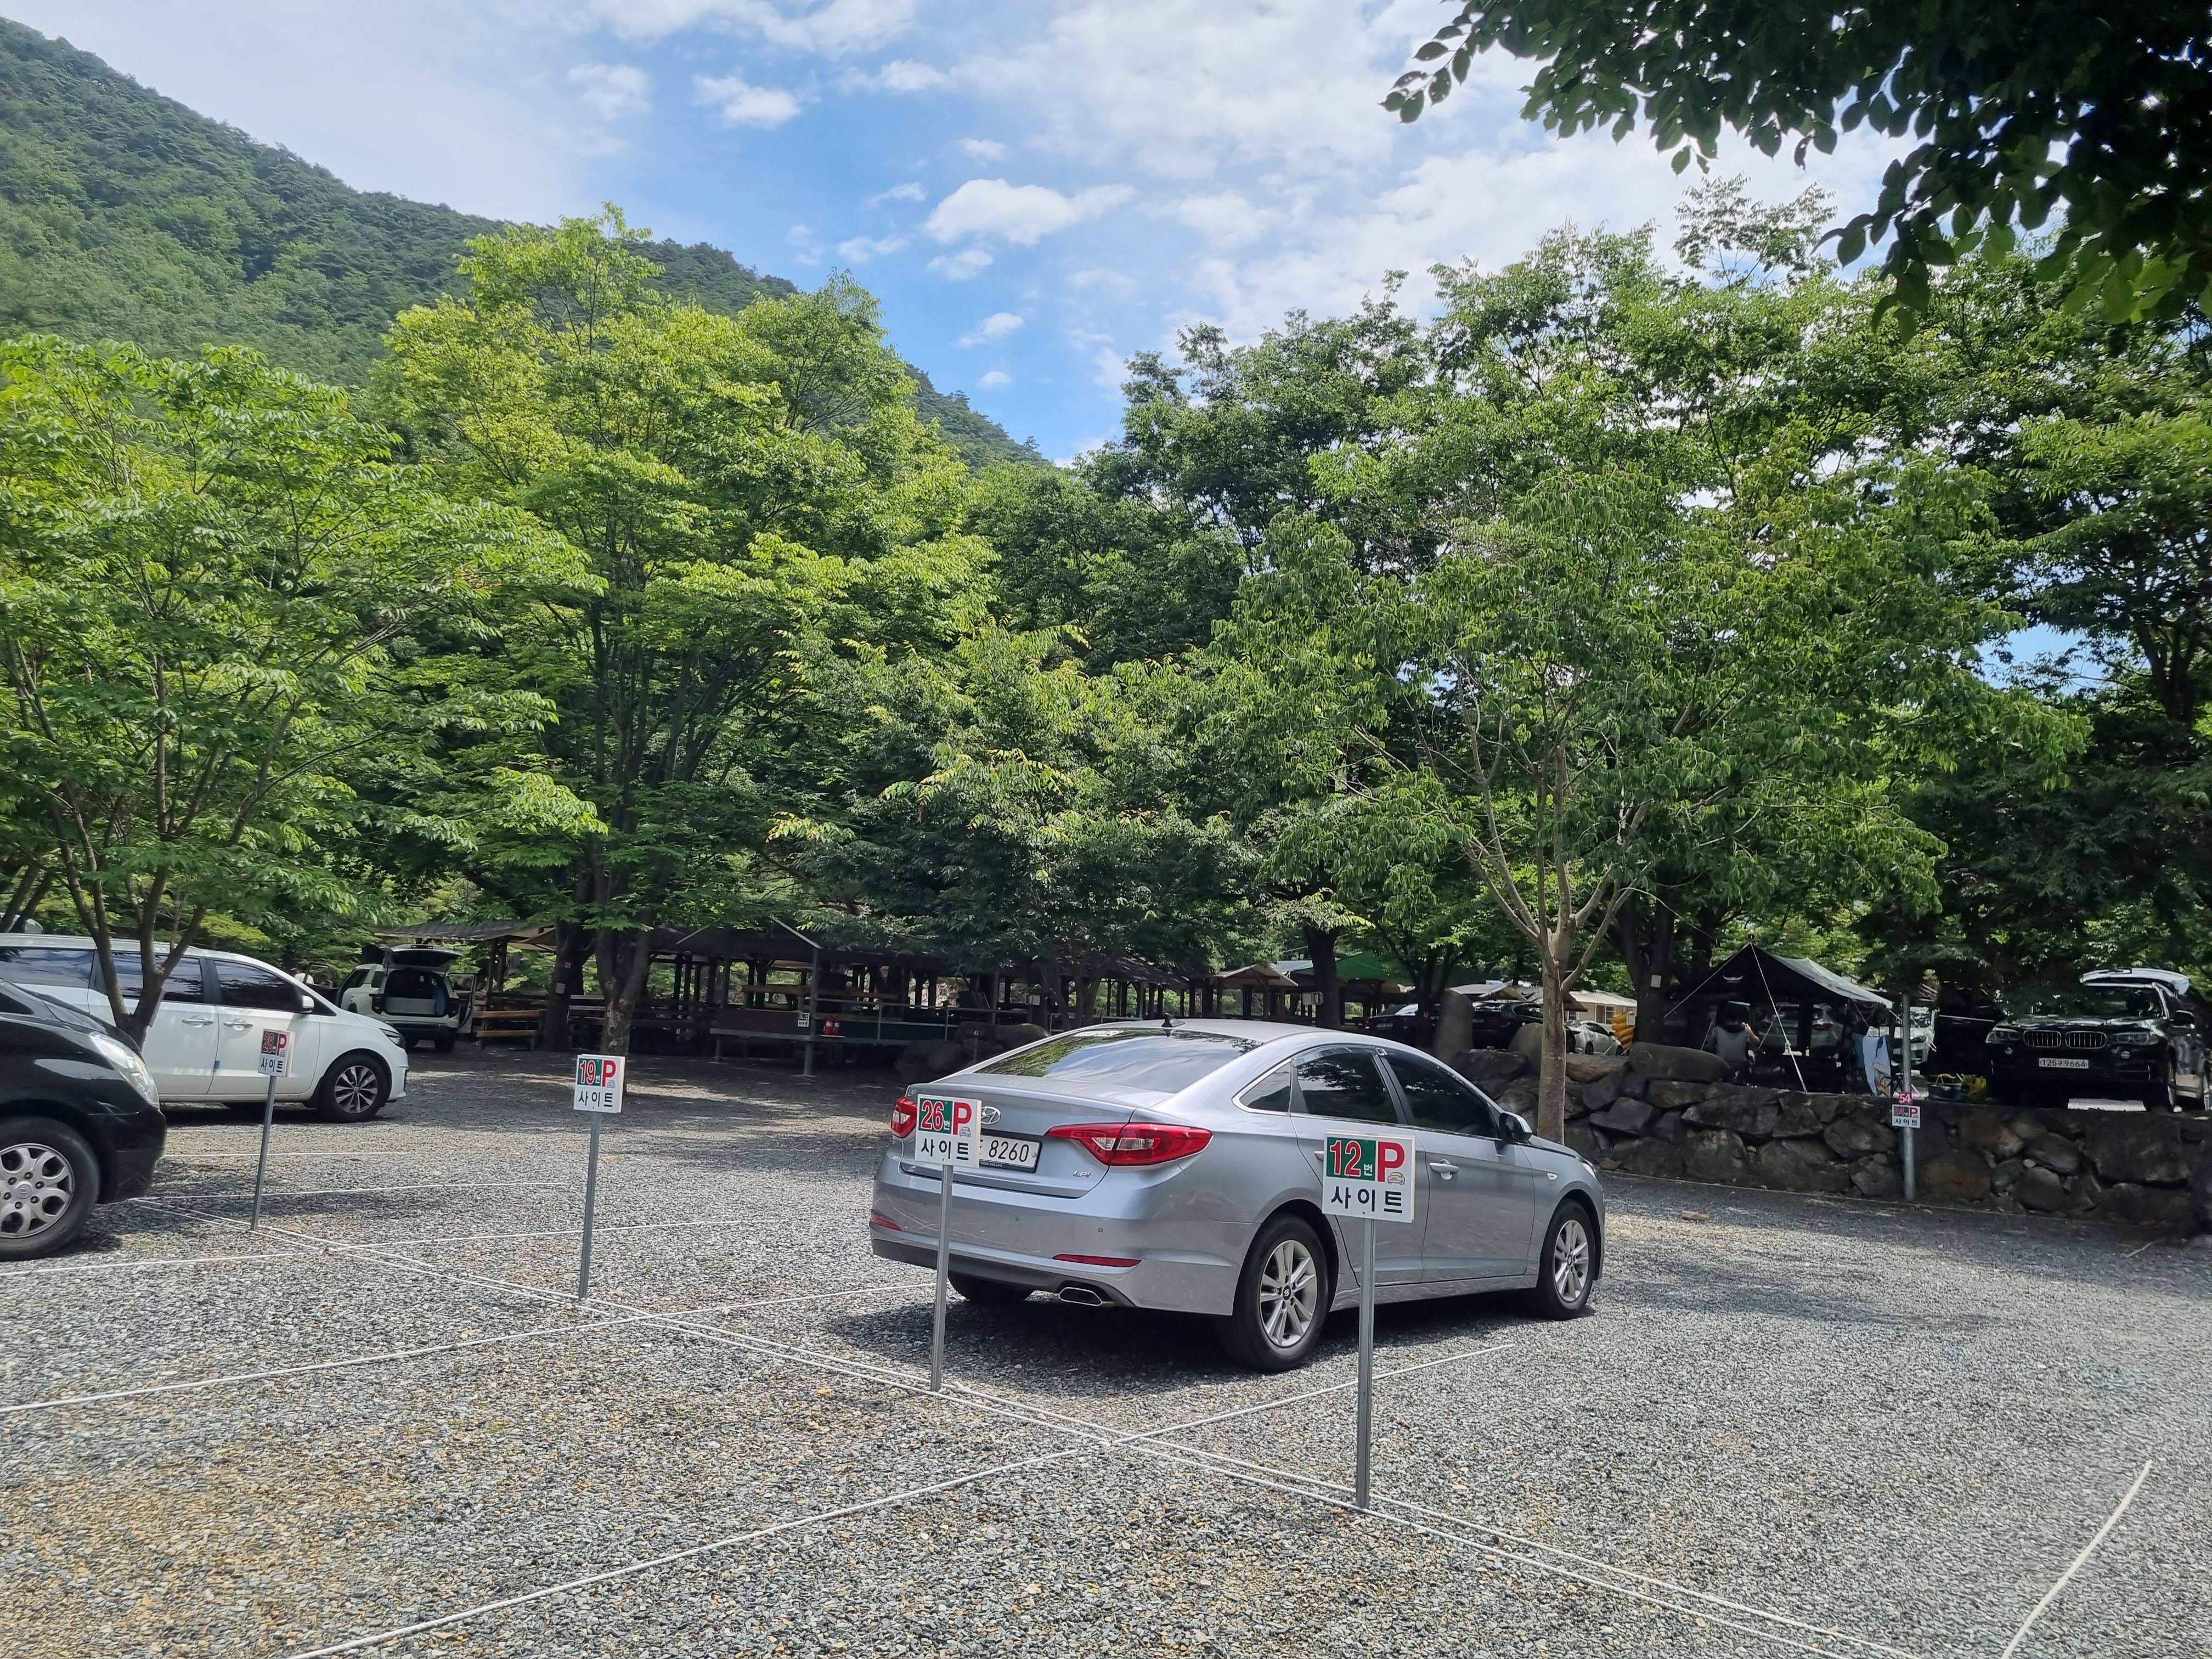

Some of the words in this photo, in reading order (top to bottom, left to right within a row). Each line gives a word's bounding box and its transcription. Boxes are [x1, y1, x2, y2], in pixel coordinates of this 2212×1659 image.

[276, 1033, 287, 1056] P
[261, 1058, 284, 1073] 사이트
[602, 1059, 617, 1087] P
[578, 1091, 613, 1107] 사이트
[1899, 1093, 1911, 1103] 54
[921, 1100, 950, 1131] 26번
[952, 1102, 972, 1135] P
[1909, 1107, 1918, 1118] P
[921, 1138, 969, 1160] 사이트
[989, 1139, 1030, 1163] 8260
[1330, 1139, 1373, 1177] 12번
[1377, 1141, 1406, 1182] P
[1331, 1186, 1403, 1214] 사이트
